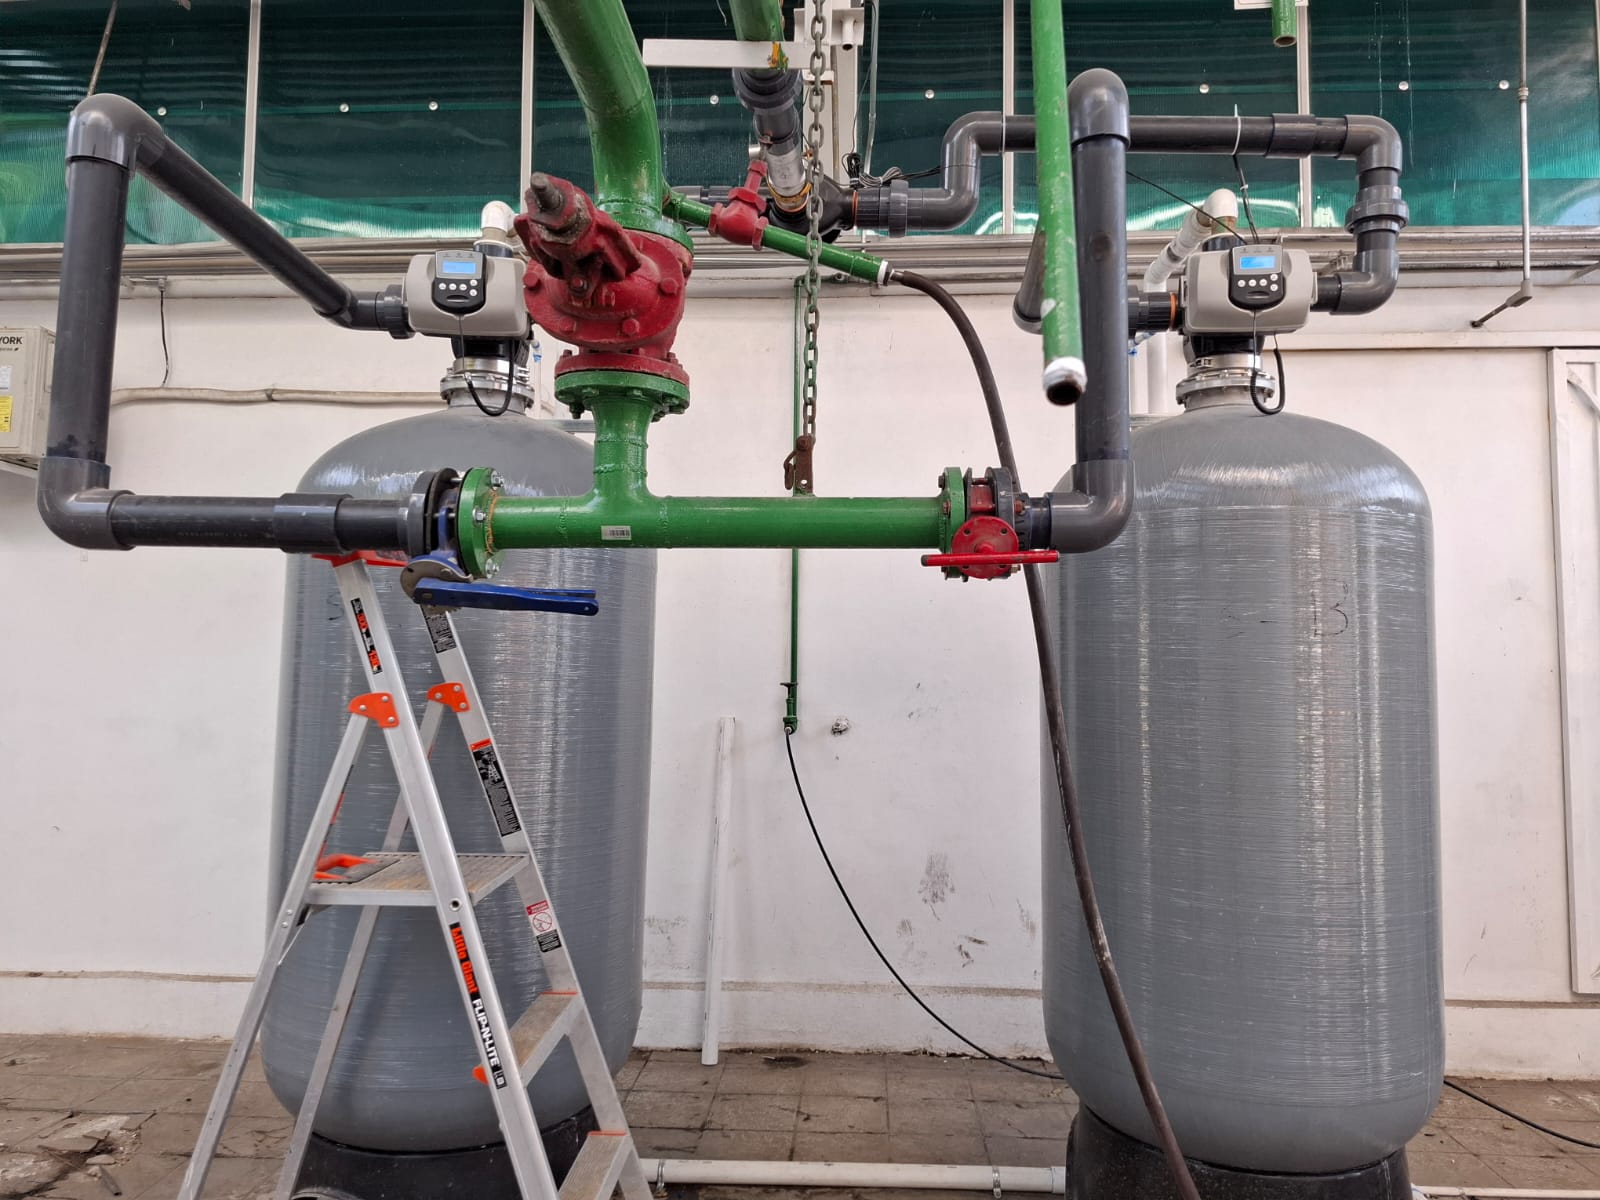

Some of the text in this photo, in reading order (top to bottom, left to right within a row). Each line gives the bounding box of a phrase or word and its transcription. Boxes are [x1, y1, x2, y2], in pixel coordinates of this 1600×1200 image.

[450, 926, 468, 960] Little
[461, 961, 480, 994] Giant
[472, 998, 501, 1066] FLIP-N-LITE
